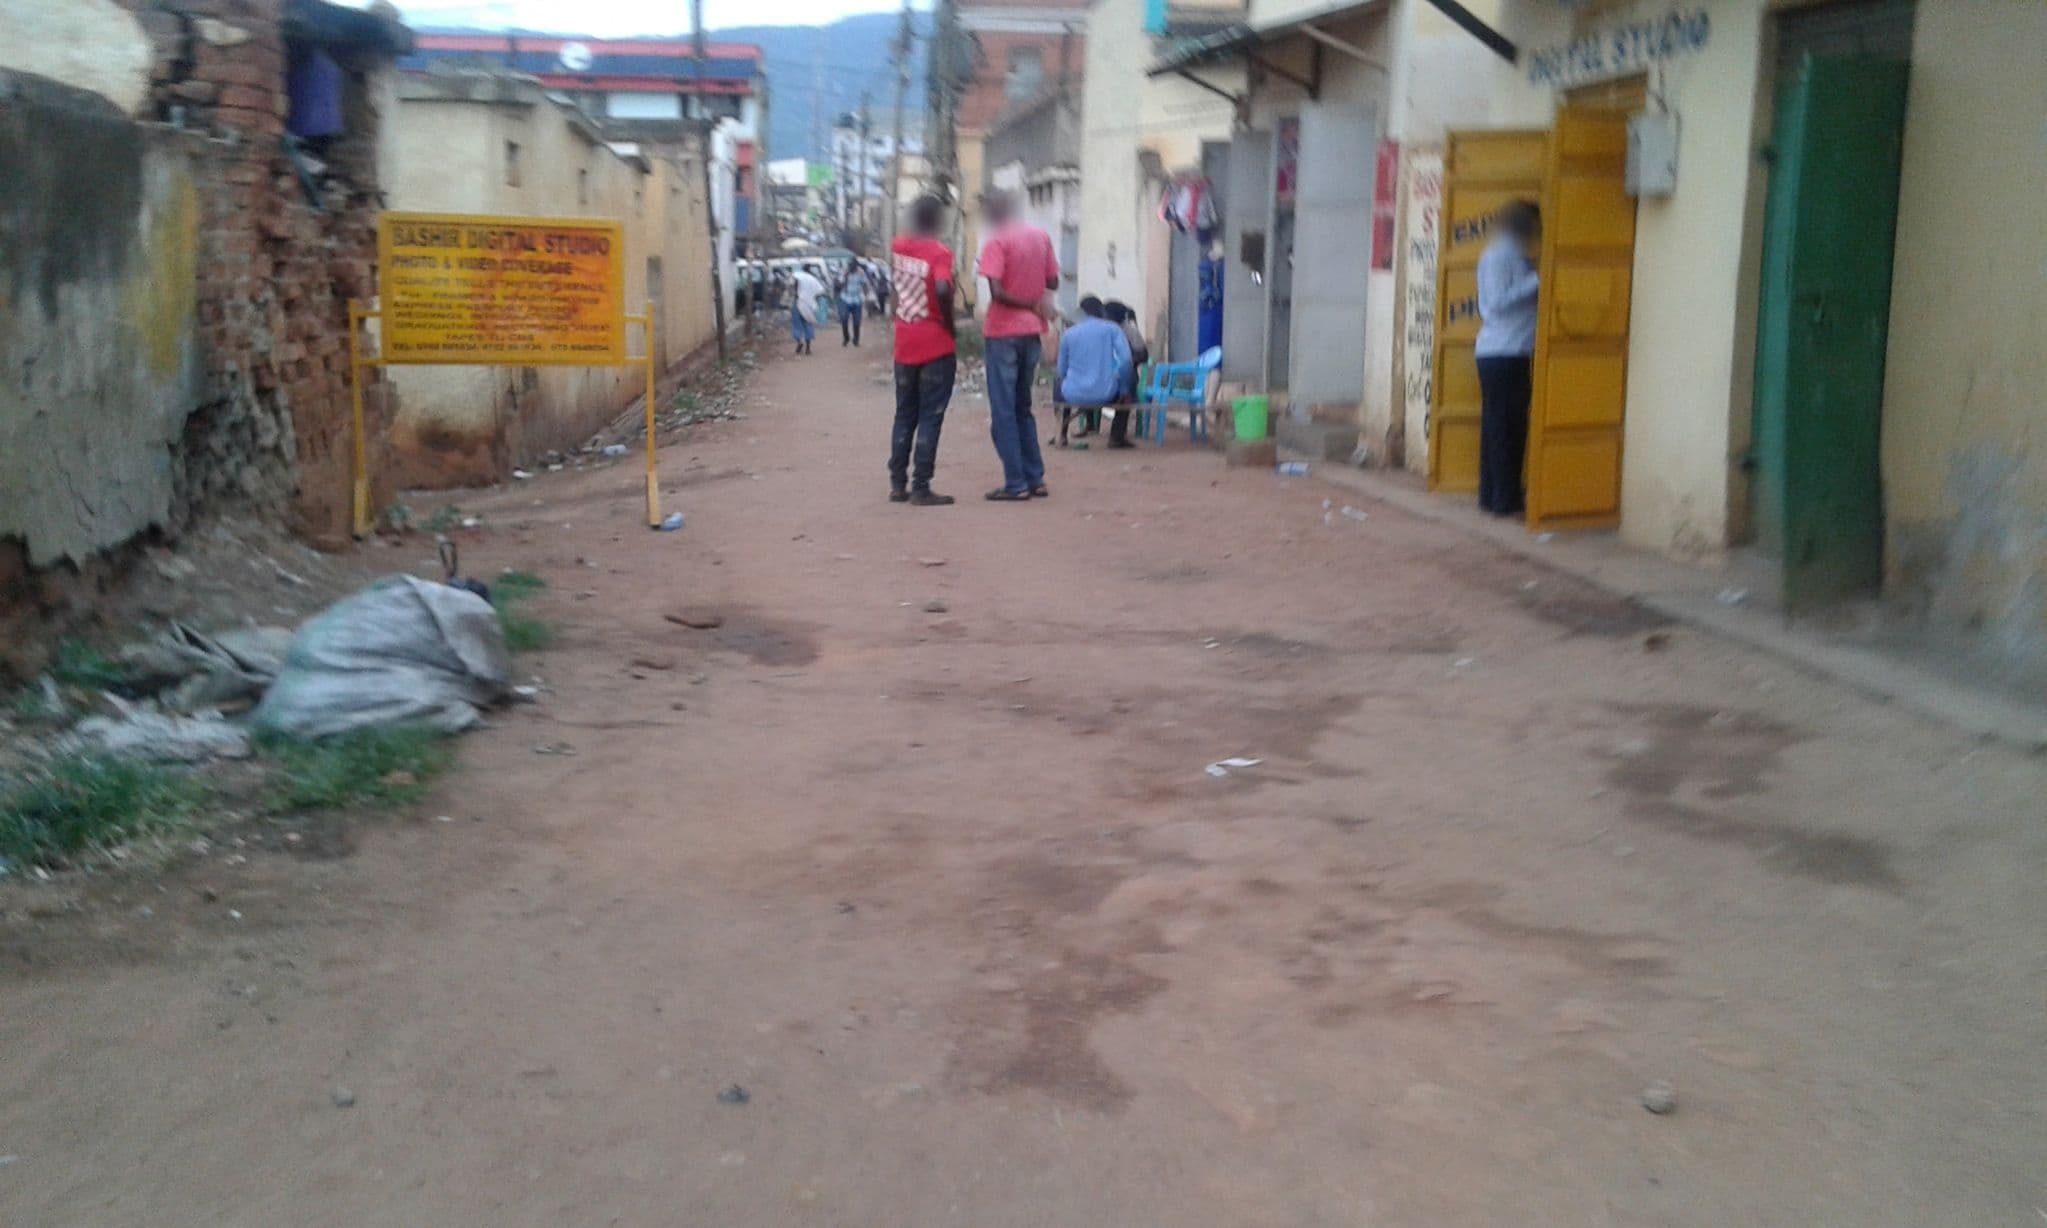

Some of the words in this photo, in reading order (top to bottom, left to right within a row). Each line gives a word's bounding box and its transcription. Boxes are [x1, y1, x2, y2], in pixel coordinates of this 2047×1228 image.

[467, 229, 537, 252] DIGITAL
[544, 233, 611, 257] STUDIO
[391, 254, 437, 270] PHOTO
[501, 258, 574, 275] COVERAGE
